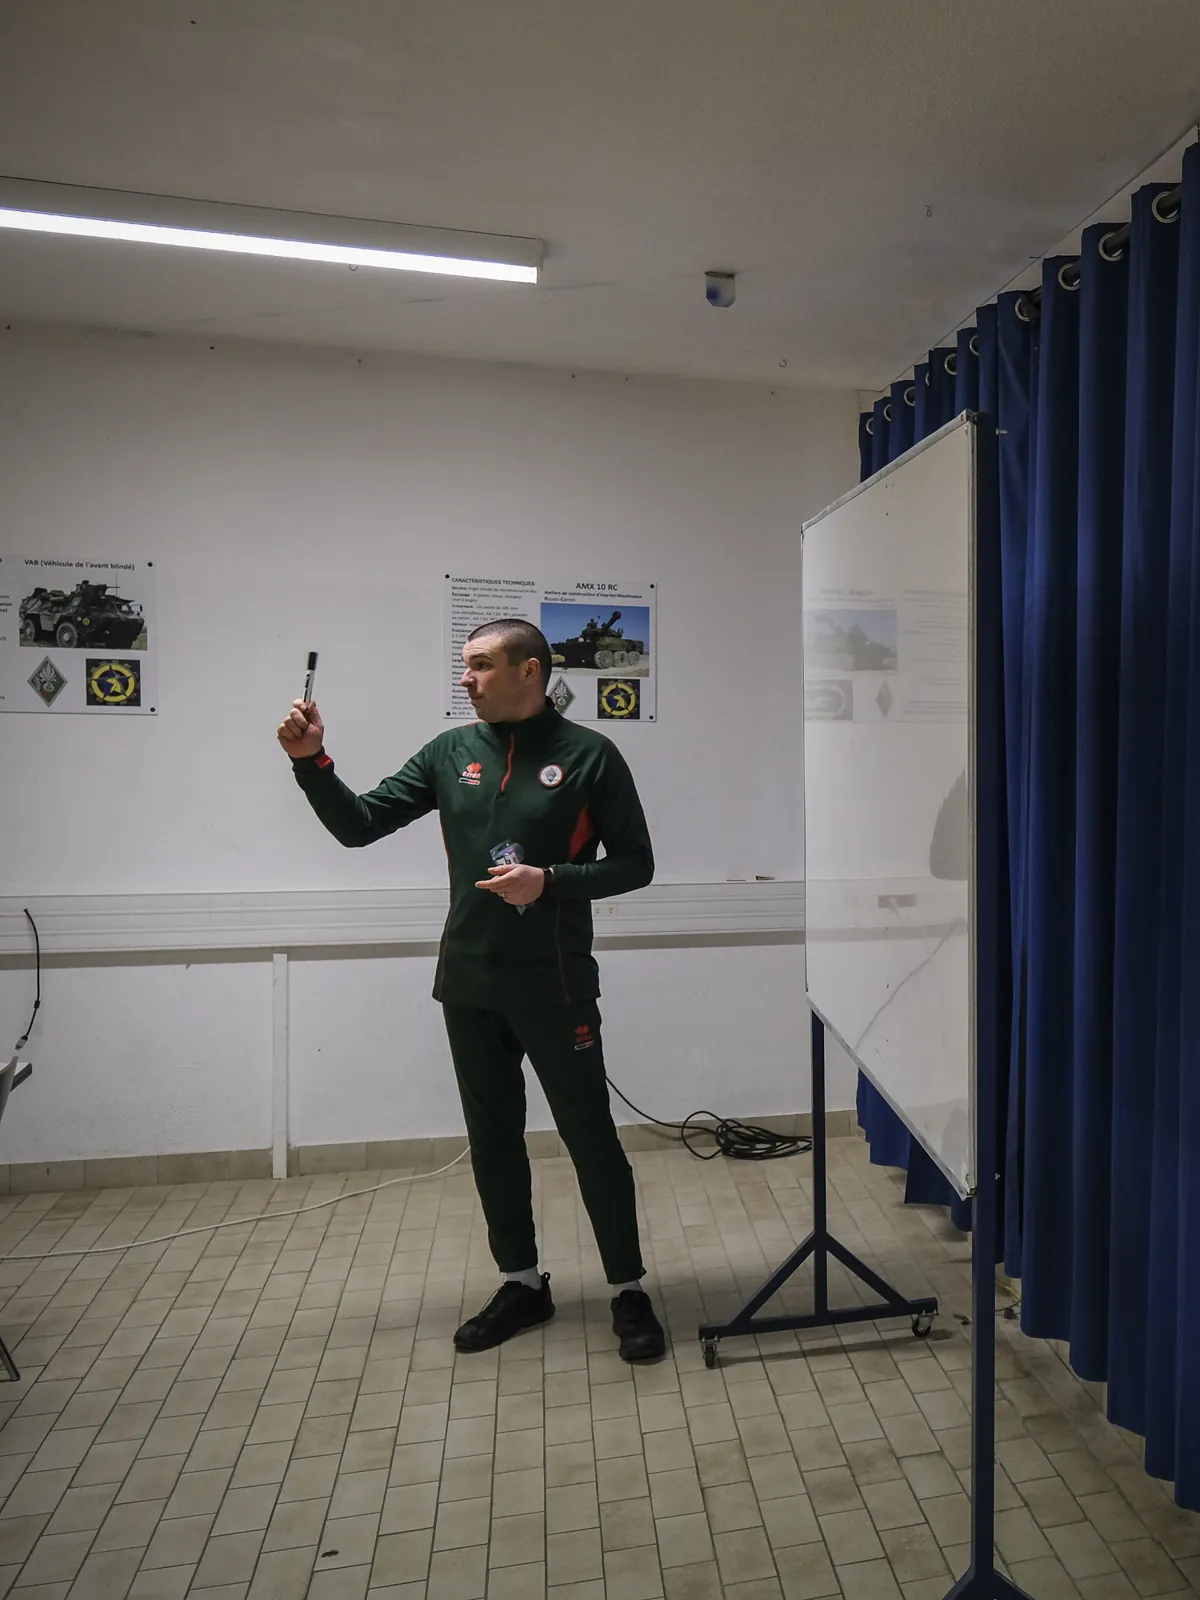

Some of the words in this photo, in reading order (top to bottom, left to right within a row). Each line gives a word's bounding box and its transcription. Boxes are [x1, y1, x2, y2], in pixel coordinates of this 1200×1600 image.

[23, 559, 39, 567] VAB
[41, 560, 74, 568] (Véhicule
[110, 563, 135, 571] blindé)
[451, 577, 502, 586] CARACTÉRISTIQUES
[502, 579, 536, 587] TECHNIQUES
[575, 582, 595, 590] AMX
[597, 583, 606, 591] 10
